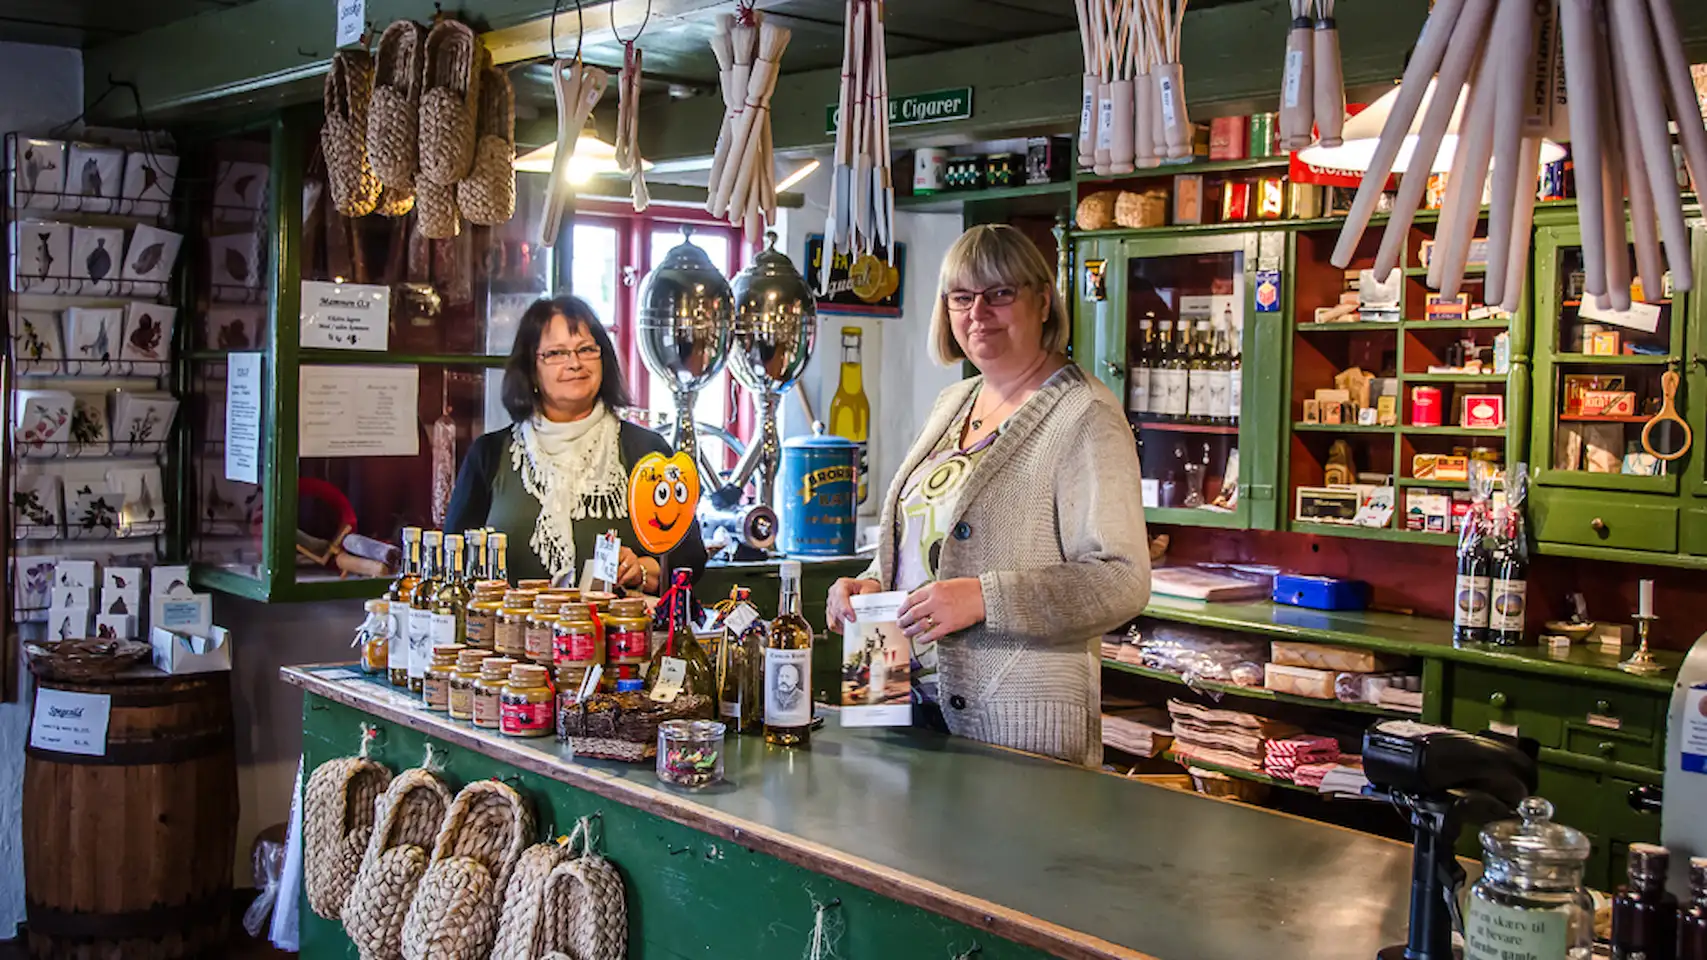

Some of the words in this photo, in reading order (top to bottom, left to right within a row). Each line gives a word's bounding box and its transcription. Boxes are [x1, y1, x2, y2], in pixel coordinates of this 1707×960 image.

[902, 97, 962, 120] Cigarer
[1493, 915, 1528, 932] skærv
[1531, 921, 1546, 934] til
[1485, 926, 1523, 946] bevare
